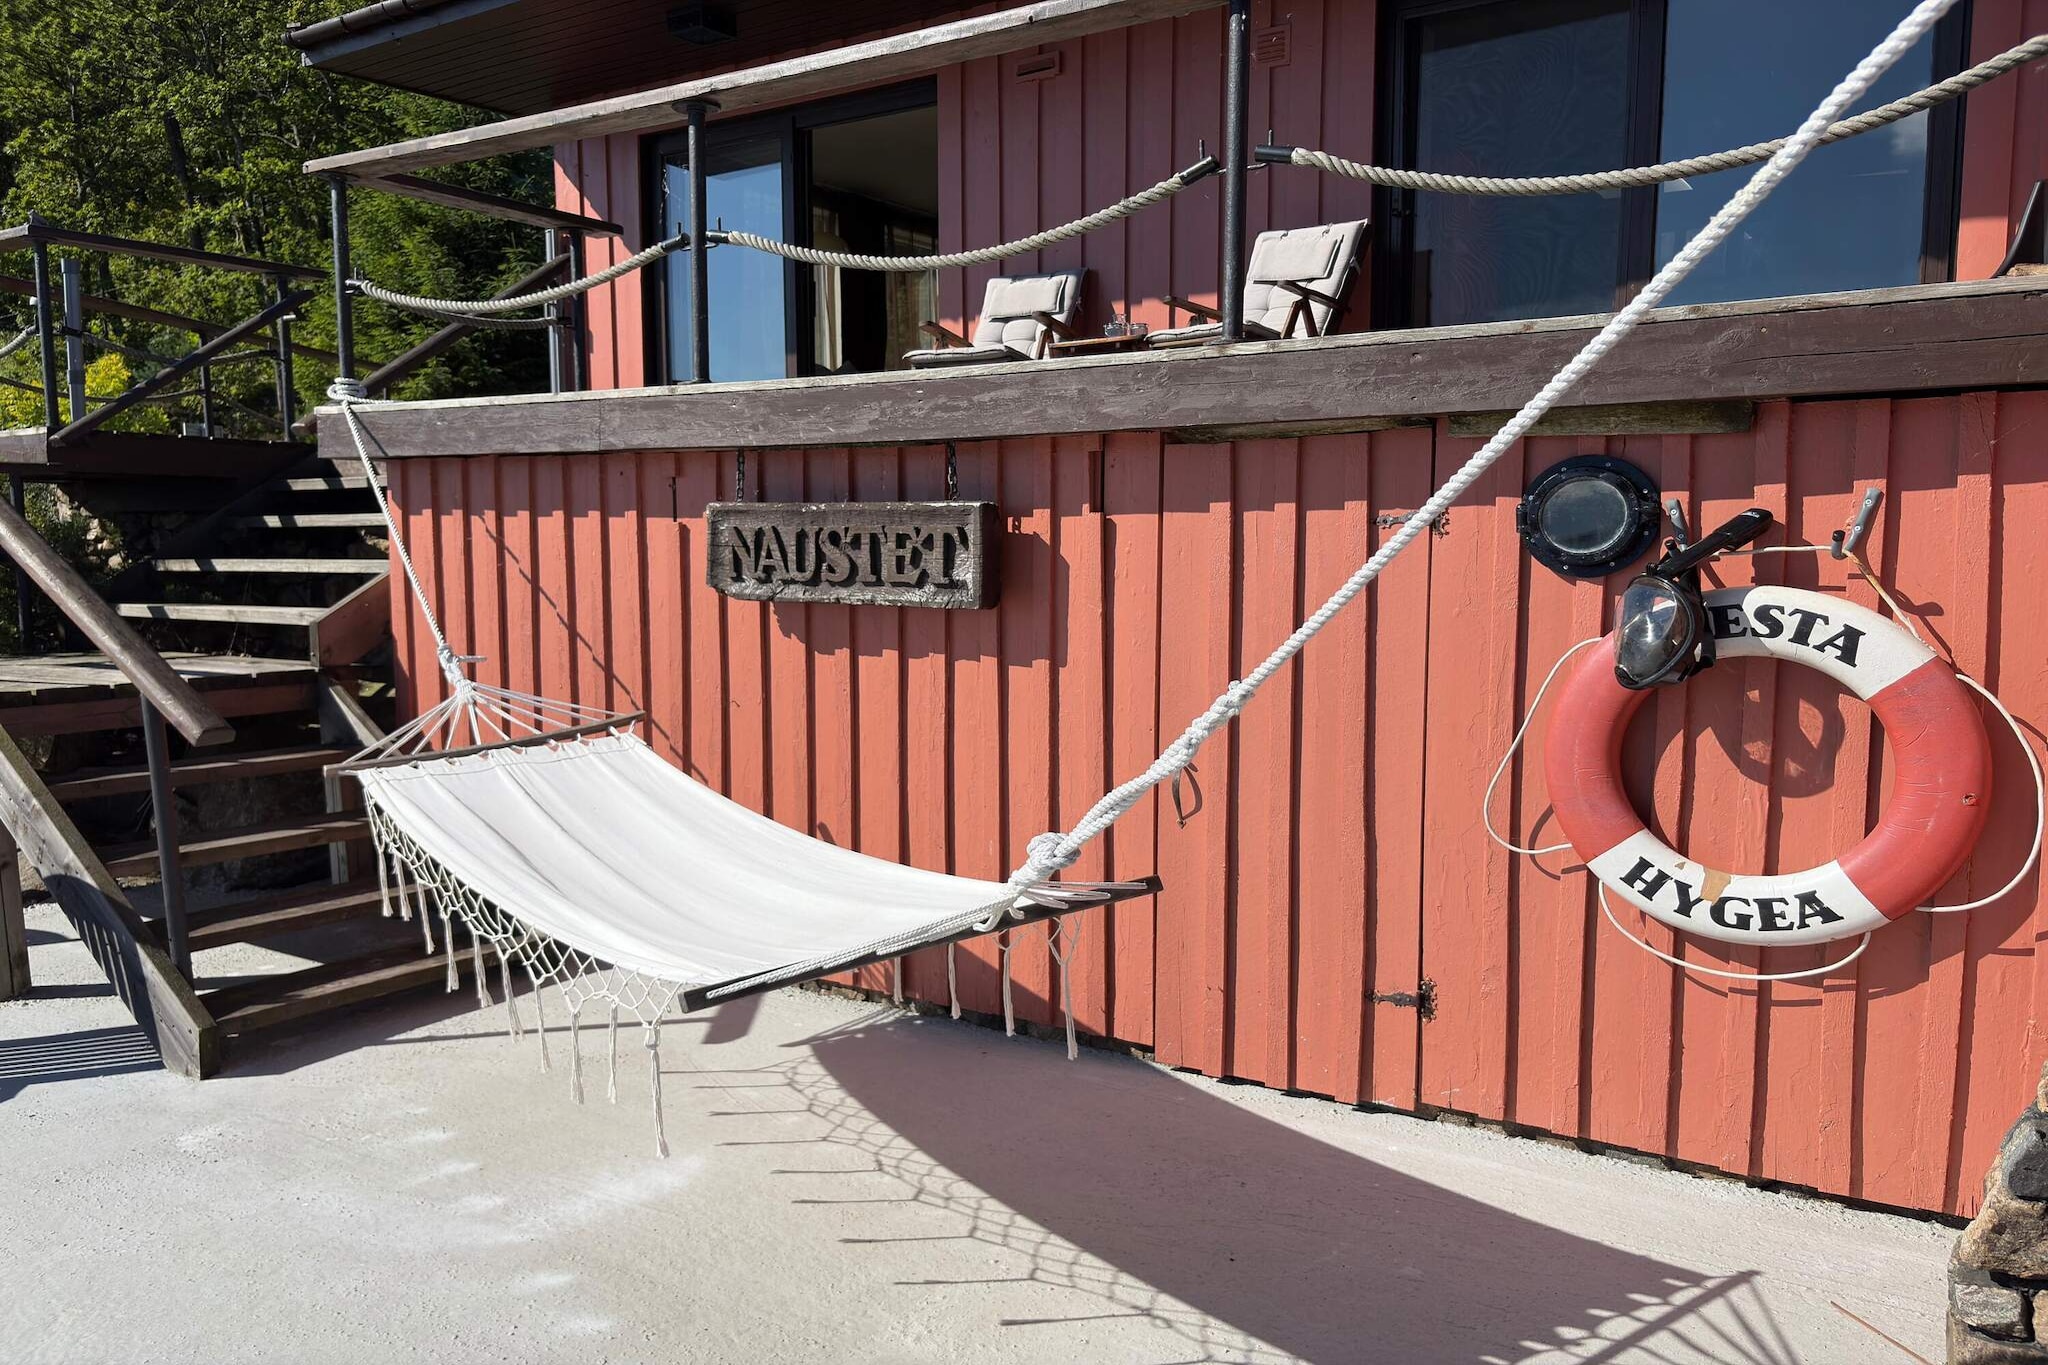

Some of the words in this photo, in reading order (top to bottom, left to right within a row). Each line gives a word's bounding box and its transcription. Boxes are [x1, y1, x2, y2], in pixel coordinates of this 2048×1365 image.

[721, 522, 970, 589] NAUSTET
[1704, 603, 1867, 668] ESTA
[1619, 855, 1845, 932] HYGEA
